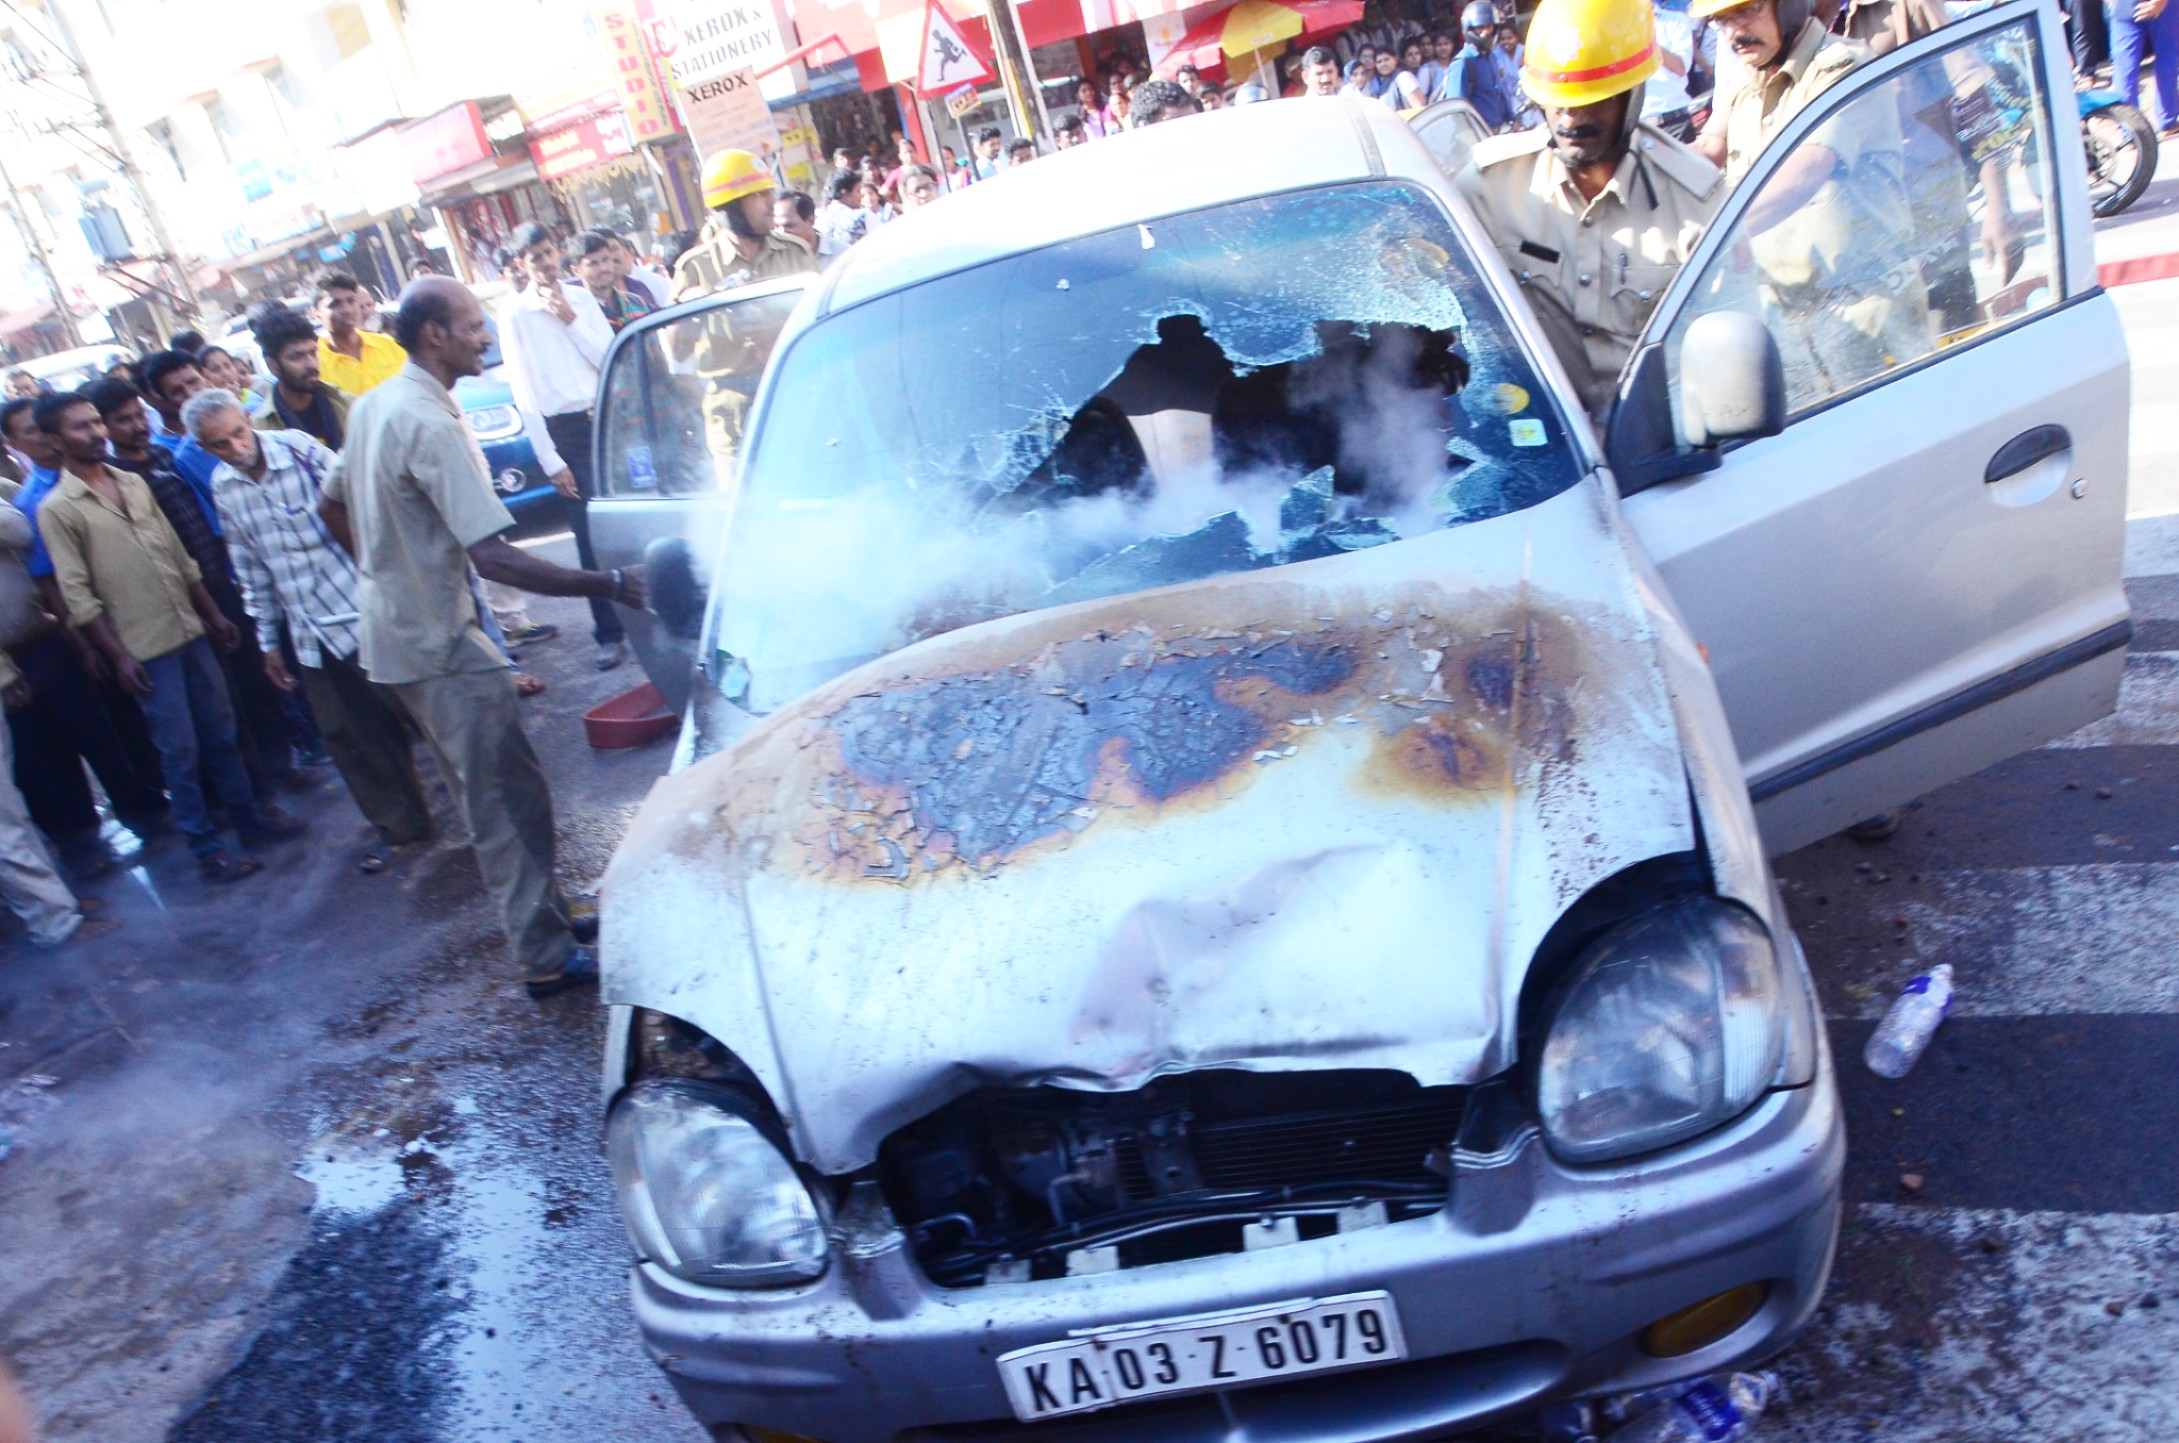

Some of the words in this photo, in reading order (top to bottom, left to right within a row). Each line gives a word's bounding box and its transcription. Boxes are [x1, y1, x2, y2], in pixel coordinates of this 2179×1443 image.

[684, 8, 749, 46] XEROX
[671, 30, 773, 80] STATIONERY
[688, 73, 749, 104] XEROX
[1254, 1308, 1387, 1370] 6079
